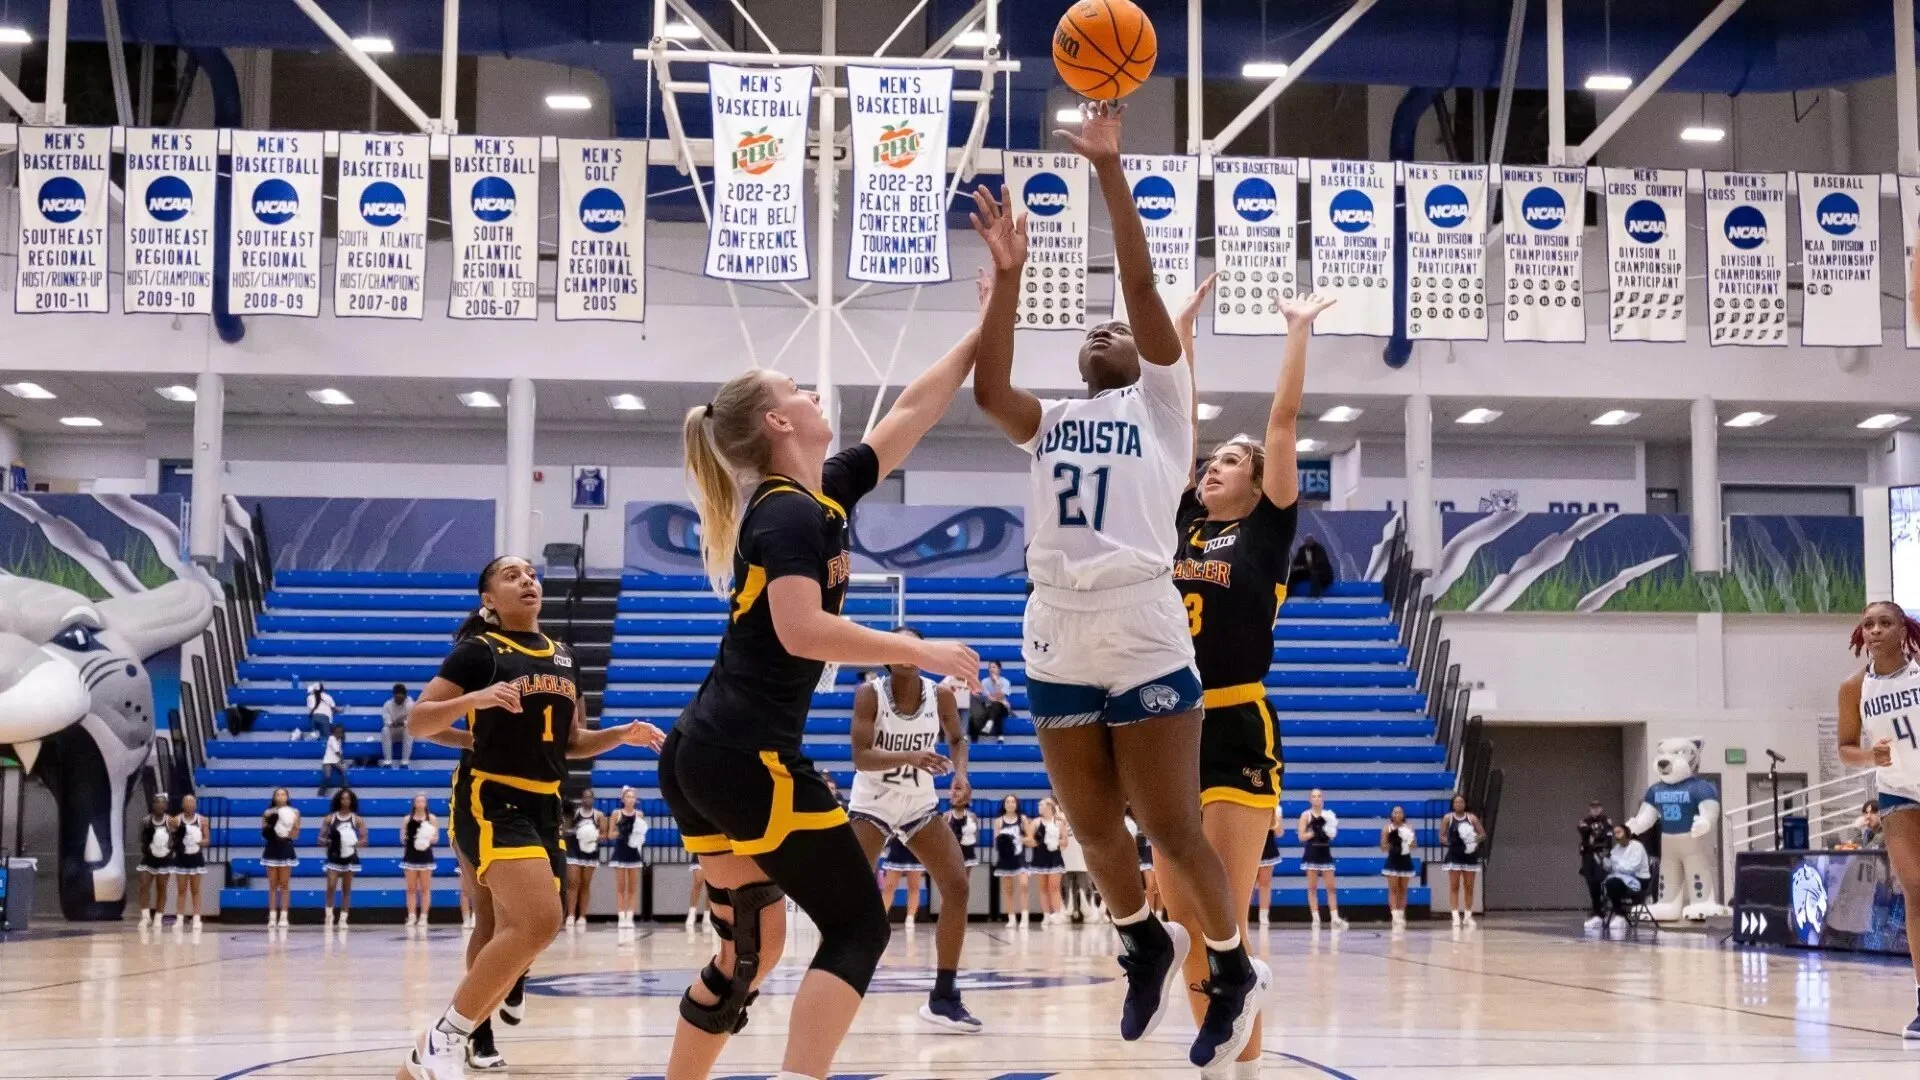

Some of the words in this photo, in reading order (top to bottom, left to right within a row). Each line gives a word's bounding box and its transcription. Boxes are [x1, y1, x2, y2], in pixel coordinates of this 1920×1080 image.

[740, 74, 782, 93] MEN'S
[879, 76, 921, 93] MEN'S
[718, 98, 802, 117] BASKETBALL
[857, 95, 944, 115] BASKETBALL
[45, 133, 85, 150] MEN'S
[151, 134, 192, 151] MEN'S
[257, 136, 298, 153] MEN'S
[365, 140, 405, 157] MEN'S
[475, 139, 515, 155] MEN'S
[873, 134, 923, 163] PBC
[24, 154, 104, 171] BASKETBALL
[129, 154, 212, 172] BASKETBALL
[582, 148, 622, 164] MEN'S
[732, 141, 780, 169] PBC
[1013, 156, 1044, 168] MEN'S
[1054, 156, 1080, 169] GOLF
[236, 156, 319, 175] BASKETBALL
[343, 160, 424, 179] BASKETBALL
[455, 157, 535, 174] BASKETBALL
[1122, 159, 1152, 171] MEN'S
[1163, 160, 1188, 172] GOLF
[1216, 162, 1240, 173] MEN'S
[1243, 162, 1295, 175] BASKETBALL
[1331, 164, 1375, 175] WOMEN'S
[585, 166, 617, 182] GOLF
[1409, 169, 1438, 180] MEN'S
[1448, 169, 1483, 181] TENNIS
[1504, 170, 1543, 182] WOMEN'S
[1553, 171, 1584, 183] TENNIS
[1634, 171, 1658, 182] MEN'S
[1724, 175, 1767, 187] WOMEN'S
[869, 174, 933, 192] 2022-23
[1320, 176, 1384, 189] BASKETBALL
[1609, 184, 1637, 195] CROSS
[1645, 185, 1683, 197] COUNTRY
[1813, 177, 1864, 189] BASEBALL
[728, 183, 790, 201] 2022-23
[1027, 193, 1069, 206] NCAA
[1708, 189, 1736, 201] CROSS
[1745, 189, 1783, 202] COUNTRY
[42, 198, 85, 212] NCAA
[149, 198, 192, 212] NCAA
[256, 200, 298, 214] NCAA
[364, 202, 406, 217] NCAA
[474, 198, 516, 212] NCAA
[860, 193, 900, 213] PEACH
[910, 193, 940, 212] BELT
[1137, 196, 1175, 209] NCAA
[1236, 198, 1277, 211] NCAA
[583, 209, 625, 223] NCAA
[720, 204, 757, 226] PEACH
[768, 205, 797, 225] BELT
[1333, 210, 1373, 223] NCAA
[1429, 205, 1468, 218] NCAA
[1526, 207, 1564, 220] NCAA
[1822, 213, 1859, 226] NCAA
[860, 214, 940, 233] CONFERENCE
[1629, 221, 1666, 234] NCAA
[23, 229, 103, 245] SOUTHEAST
[131, 228, 208, 245] SOUTHEAST
[237, 231, 315, 248] SOUTHEAST
[474, 226, 513, 242] SOUTH
[718, 229, 798, 250] CONFERENCE
[1146, 227, 1183, 239] DIVISION
[1218, 226, 1239, 237] NCAA
[1247, 226, 1280, 238] DIVISION
[1409, 232, 1430, 243] NCAA
[1438, 233, 1473, 245] DIVISION
[1505, 234, 1527, 245] NCAA
[1535, 234, 1569, 246] DIVISION
[1728, 226, 1767, 240] NCAA
[339, 231, 368, 247] SOUTH
[380, 232, 424, 250] ATLANTIC
[571, 240, 631, 257] CENTRAL
[862, 234, 937, 253] TOURNAMENT
[1222, 240, 1291, 253] CHAMPIONSHIP
[1315, 237, 1336, 248] NCAA
[1344, 236, 1378, 248] DIVISION
[1805, 240, 1825, 251] NCAA
[1832, 240, 1863, 252] DIVISION
[28, 250, 96, 266] REGIONAL
[136, 249, 201, 266] REGIONAL
[242, 252, 307, 268] REGIONAL
[348, 252, 412, 270] REGIONAL
[464, 245, 522, 261] ATLANTIC
[1226, 255, 1287, 267] PARTICIPANT
[1318, 250, 1387, 262] CHAMPIONSHIP
[1413, 247, 1482, 259] CHAMPIONSHIP
[1510, 250, 1579, 262] CHAMPIONSHIP
[1619, 247, 1660, 259] DIVISION
[1721, 255, 1761, 267] DIVISION
[1808, 254, 1874, 266] CHAMPIONSHIP
[463, 263, 522, 279] REGIONAL
[570, 259, 633, 276] REGIONAL
[717, 254, 798, 274] CHAMPIONS
[860, 256, 940, 275] CHAMPIONS
[1322, 263, 1384, 275] PARTICIPANT
[1418, 263, 1478, 275] PARTICIPANT
[1515, 264, 1574, 277] PARTICIPANT
[1615, 262, 1682, 274] CHAMPIONSHIP
[22, 271, 103, 288] HOST/RUNNER-UP
[128, 271, 210, 288] HOST/CHAMPIONS
[233, 272, 316, 289] HOST/CHAMPIONS
[340, 272, 420, 291] HOST/CHAMPIONS
[1618, 276, 1679, 289] PARTICIPANT
[1715, 269, 1781, 281] CHAMPIONSHIP
[1812, 269, 1871, 280] PARTICIPANT
[512, 282, 535, 298] SEED
[564, 278, 638, 295] CHAMPIONS
[1719, 282, 1779, 295] PARTICIPANT
[36, 292, 89, 309] 2010-11
[137, 291, 195, 307] 2009-10
[244, 293, 303, 310] 2008-09
[350, 294, 408, 311] 2007-08
[584, 296, 616, 311] 2005
[466, 300, 520, 316] 2006-07
[1054, 461, 1112, 532] 21
[1172, 558, 1231, 589] AGLER
[1864, 688, 1920, 719] AUGUST
[542, 705, 554, 742] 1
[1892, 715, 1917, 749] 4
